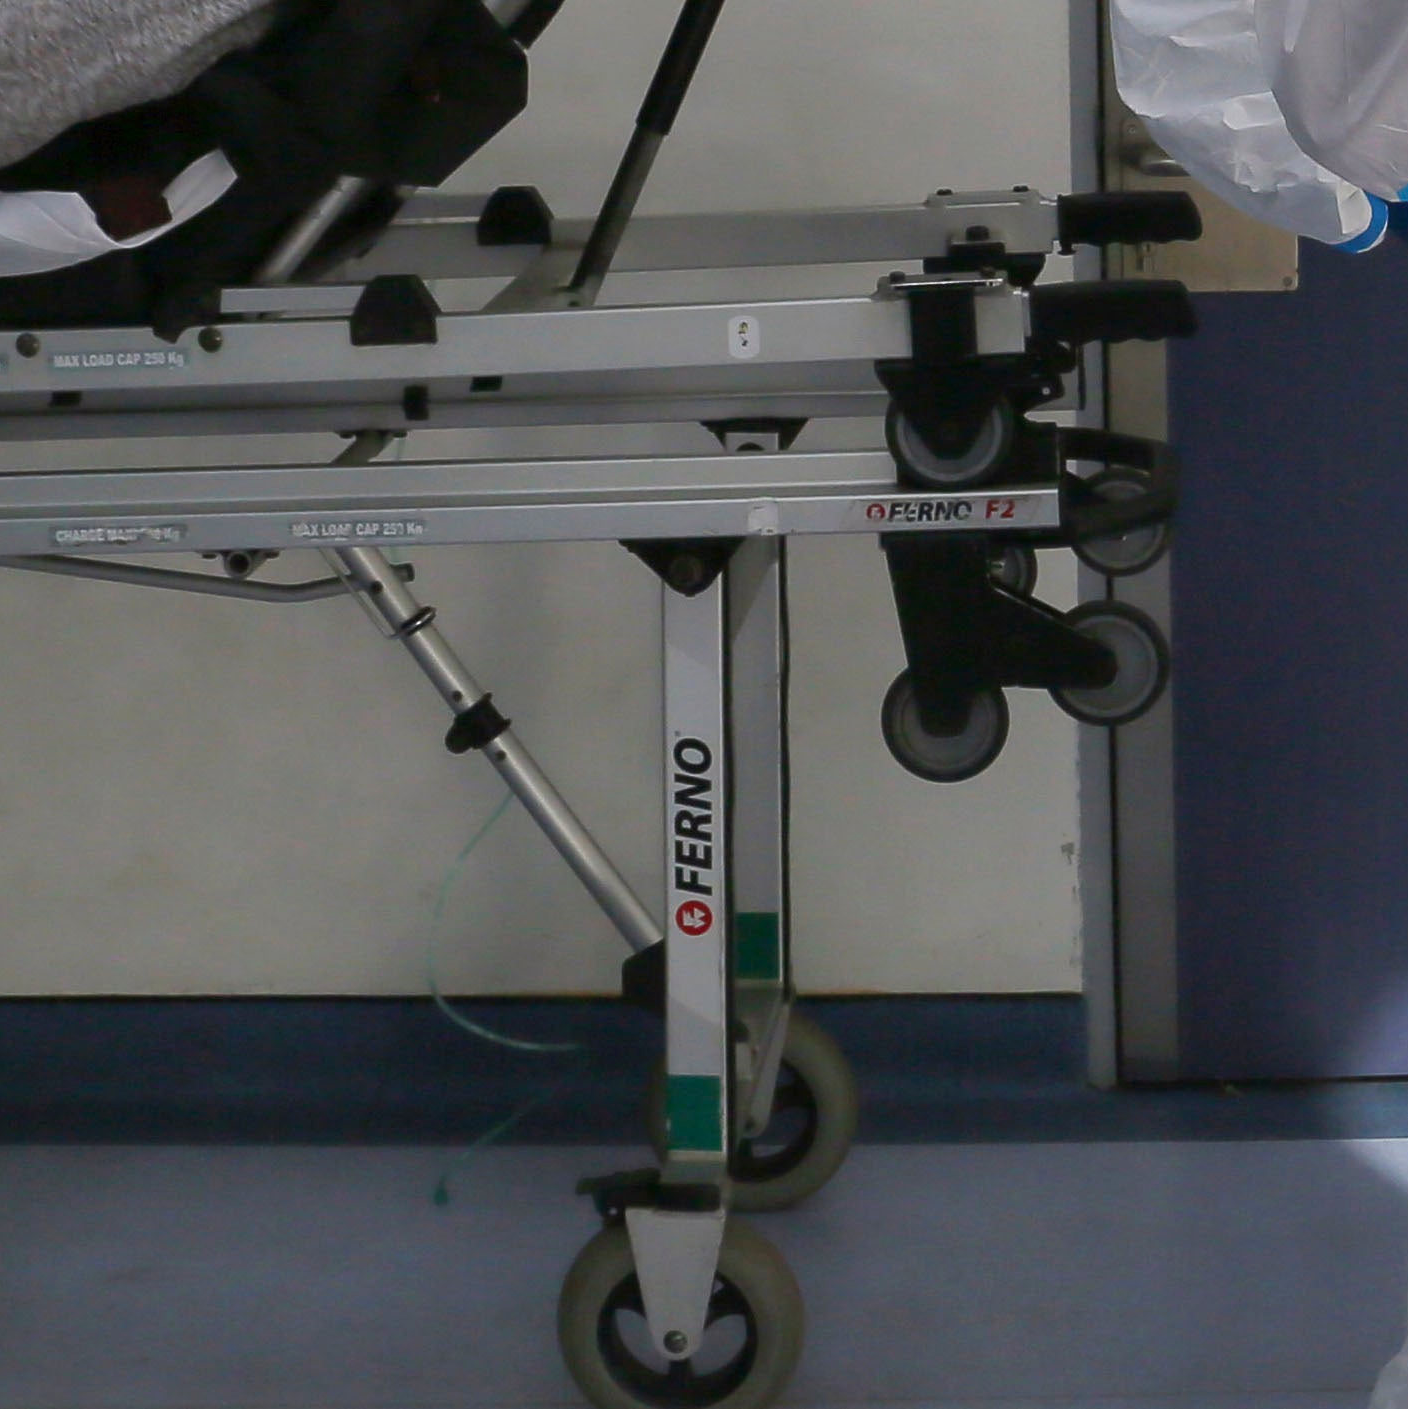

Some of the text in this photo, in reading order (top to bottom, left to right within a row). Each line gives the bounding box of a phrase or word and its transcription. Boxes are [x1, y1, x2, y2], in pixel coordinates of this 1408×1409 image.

[54, 355, 79, 367] MAX
[83, 354, 114, 367] LOAD
[117, 353, 141, 366] CAP
[888, 499, 1015, 522] FERNO F2
[356, 523, 380, 536] CAP
[673, 738, 713, 896] FERNO
